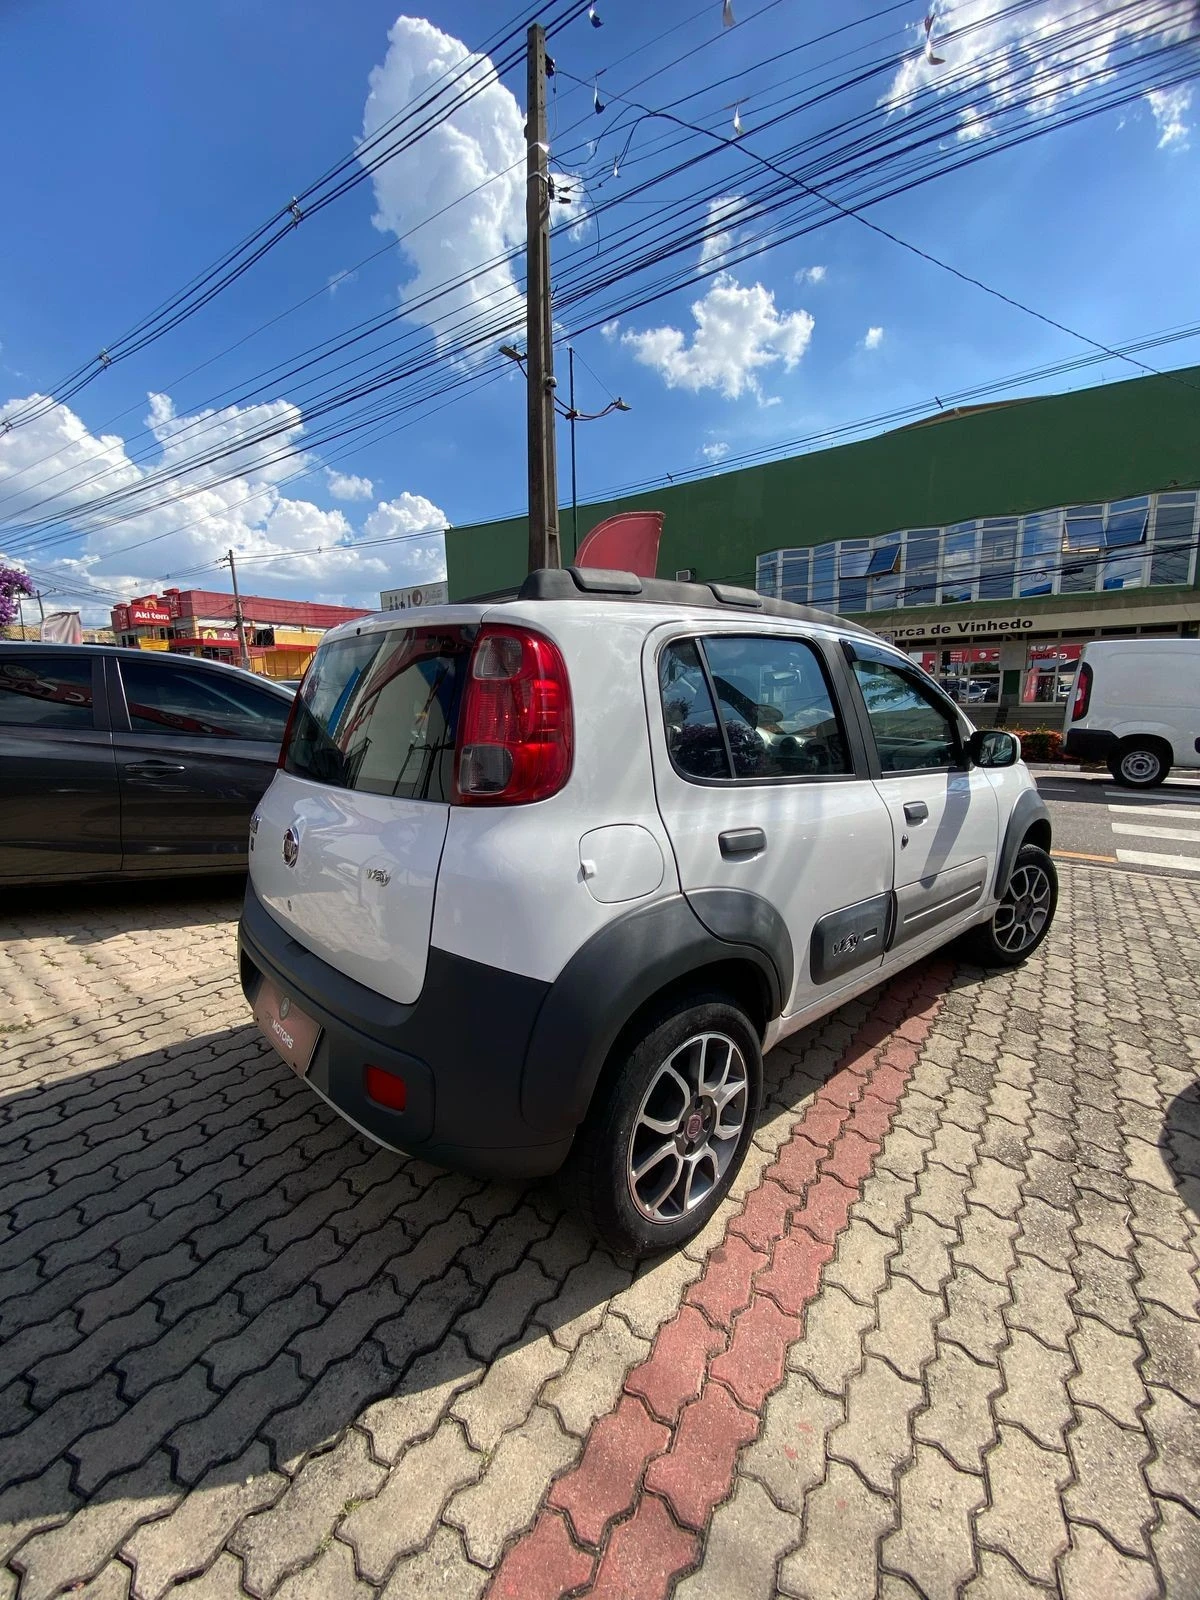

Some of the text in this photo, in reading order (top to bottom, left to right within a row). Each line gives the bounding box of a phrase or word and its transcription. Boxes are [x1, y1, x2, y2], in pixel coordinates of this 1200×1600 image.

[135, 611, 150, 619] Aki
[930, 624, 952, 635] de
[957, 618, 1033, 633] Vinhedo
[271, 1019, 294, 1049] MOTORS
